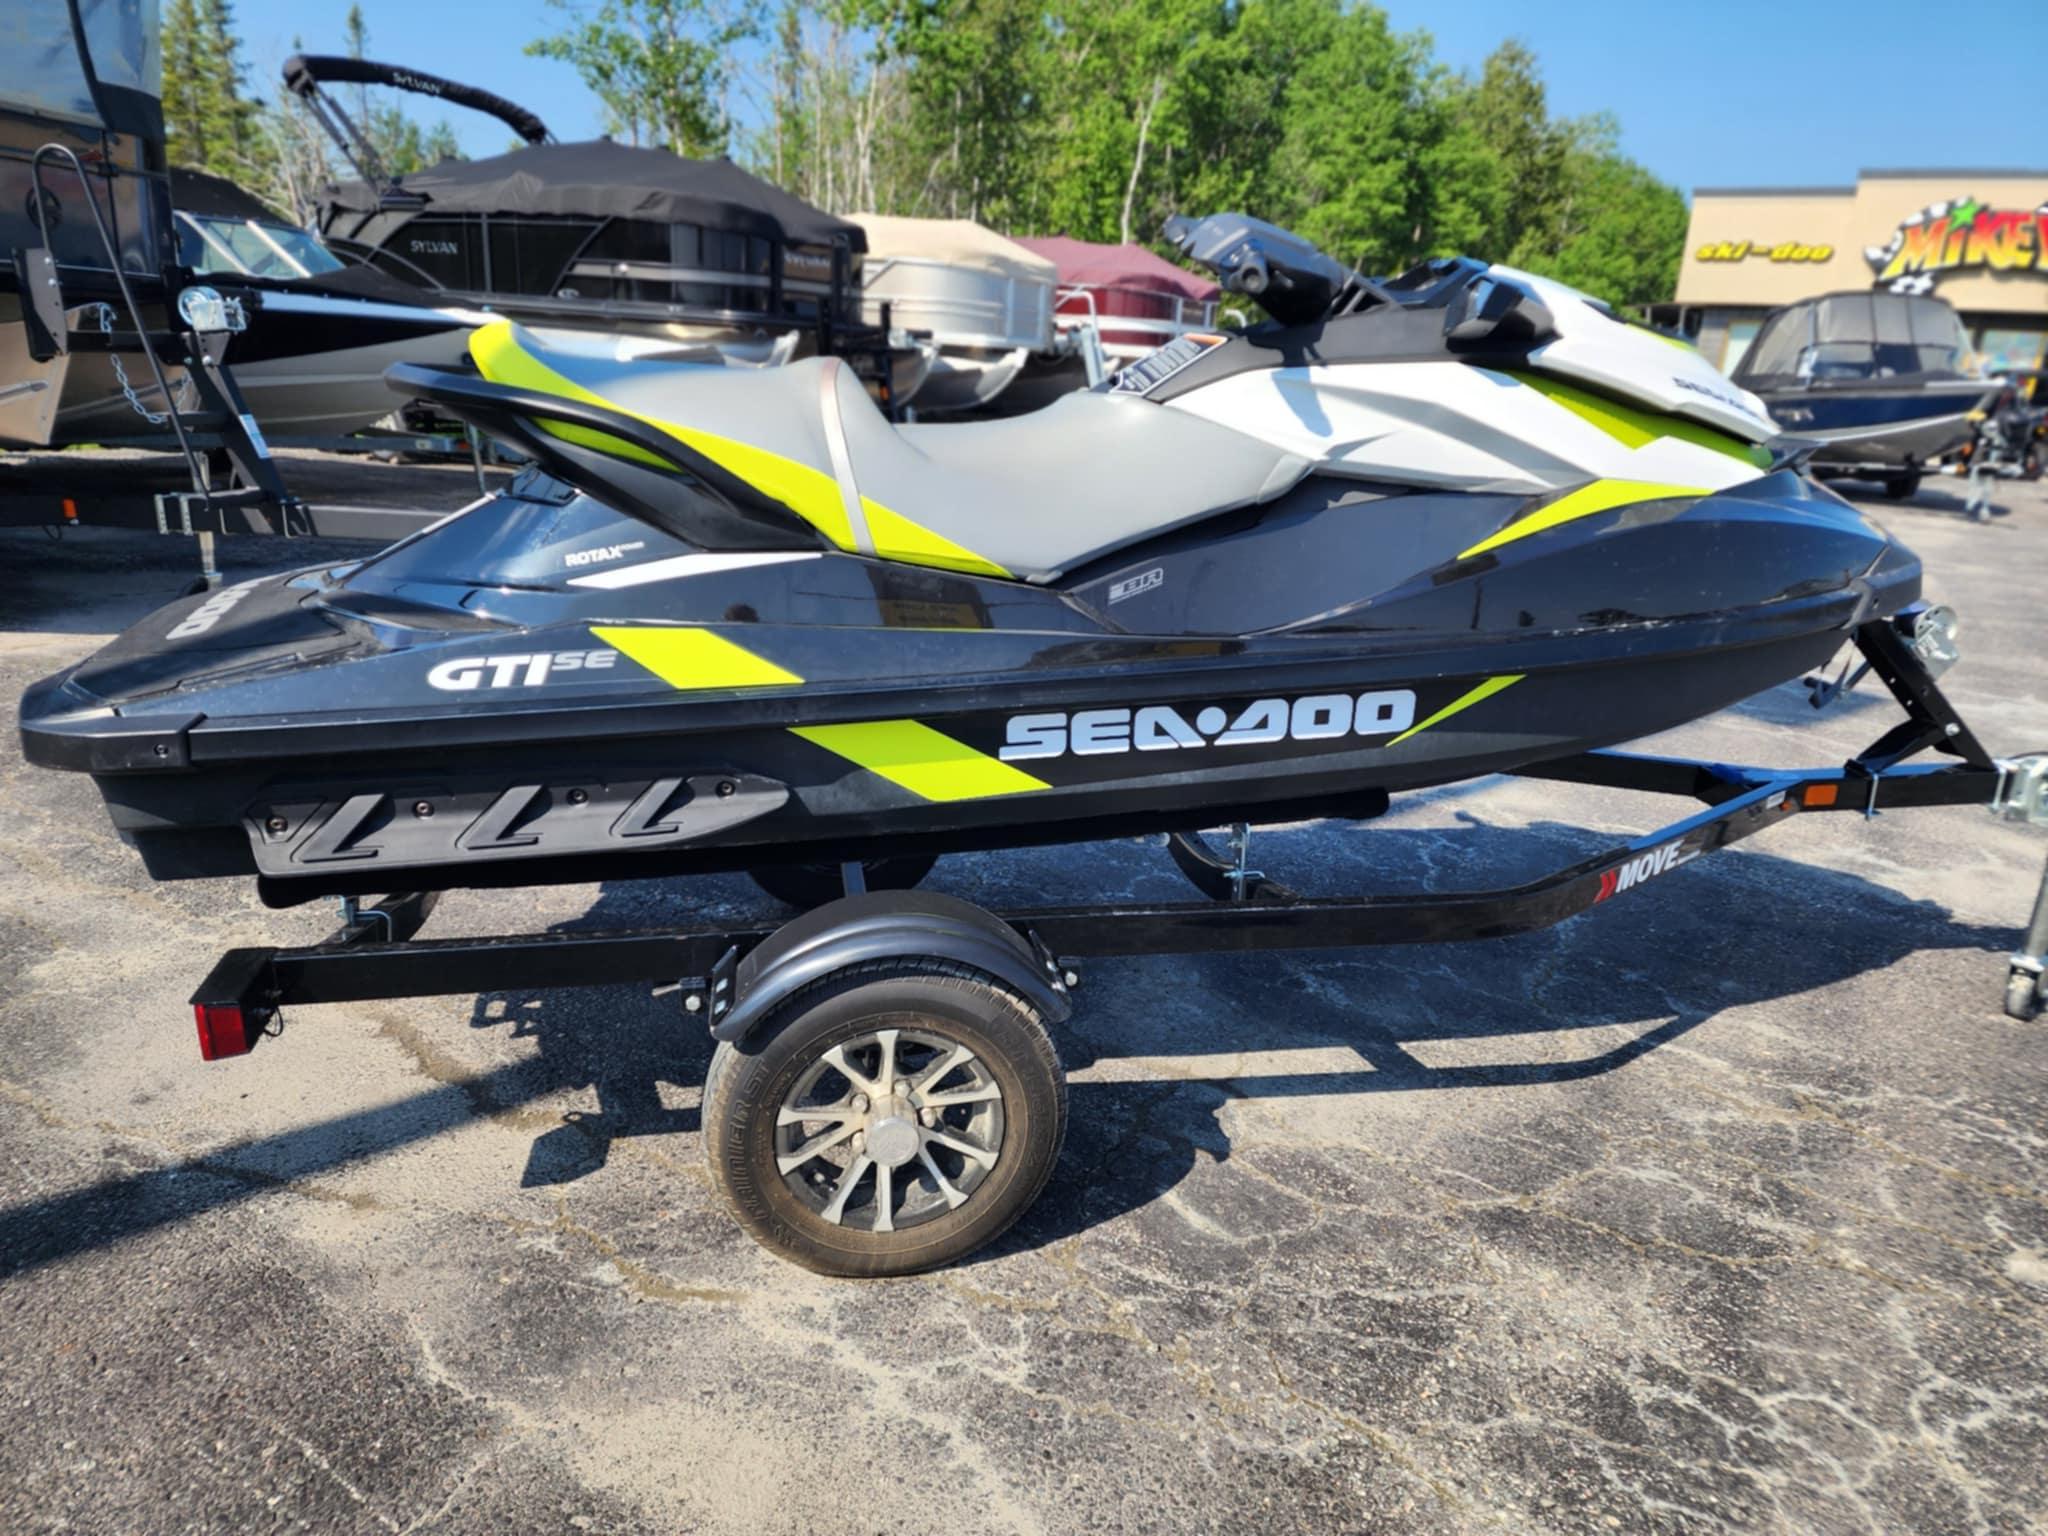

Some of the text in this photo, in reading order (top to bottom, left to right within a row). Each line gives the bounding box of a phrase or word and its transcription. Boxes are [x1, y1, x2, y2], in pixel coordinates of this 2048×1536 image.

[393, 71, 440, 94] SYLVAN
[410, 240, 458, 254] SYLVAN
[1695, 239, 1835, 262] ski-doo
[564, 544, 624, 567] ROTAX
[427, 649, 618, 691] GTI SE
[1615, 839, 1685, 894] MOVE
